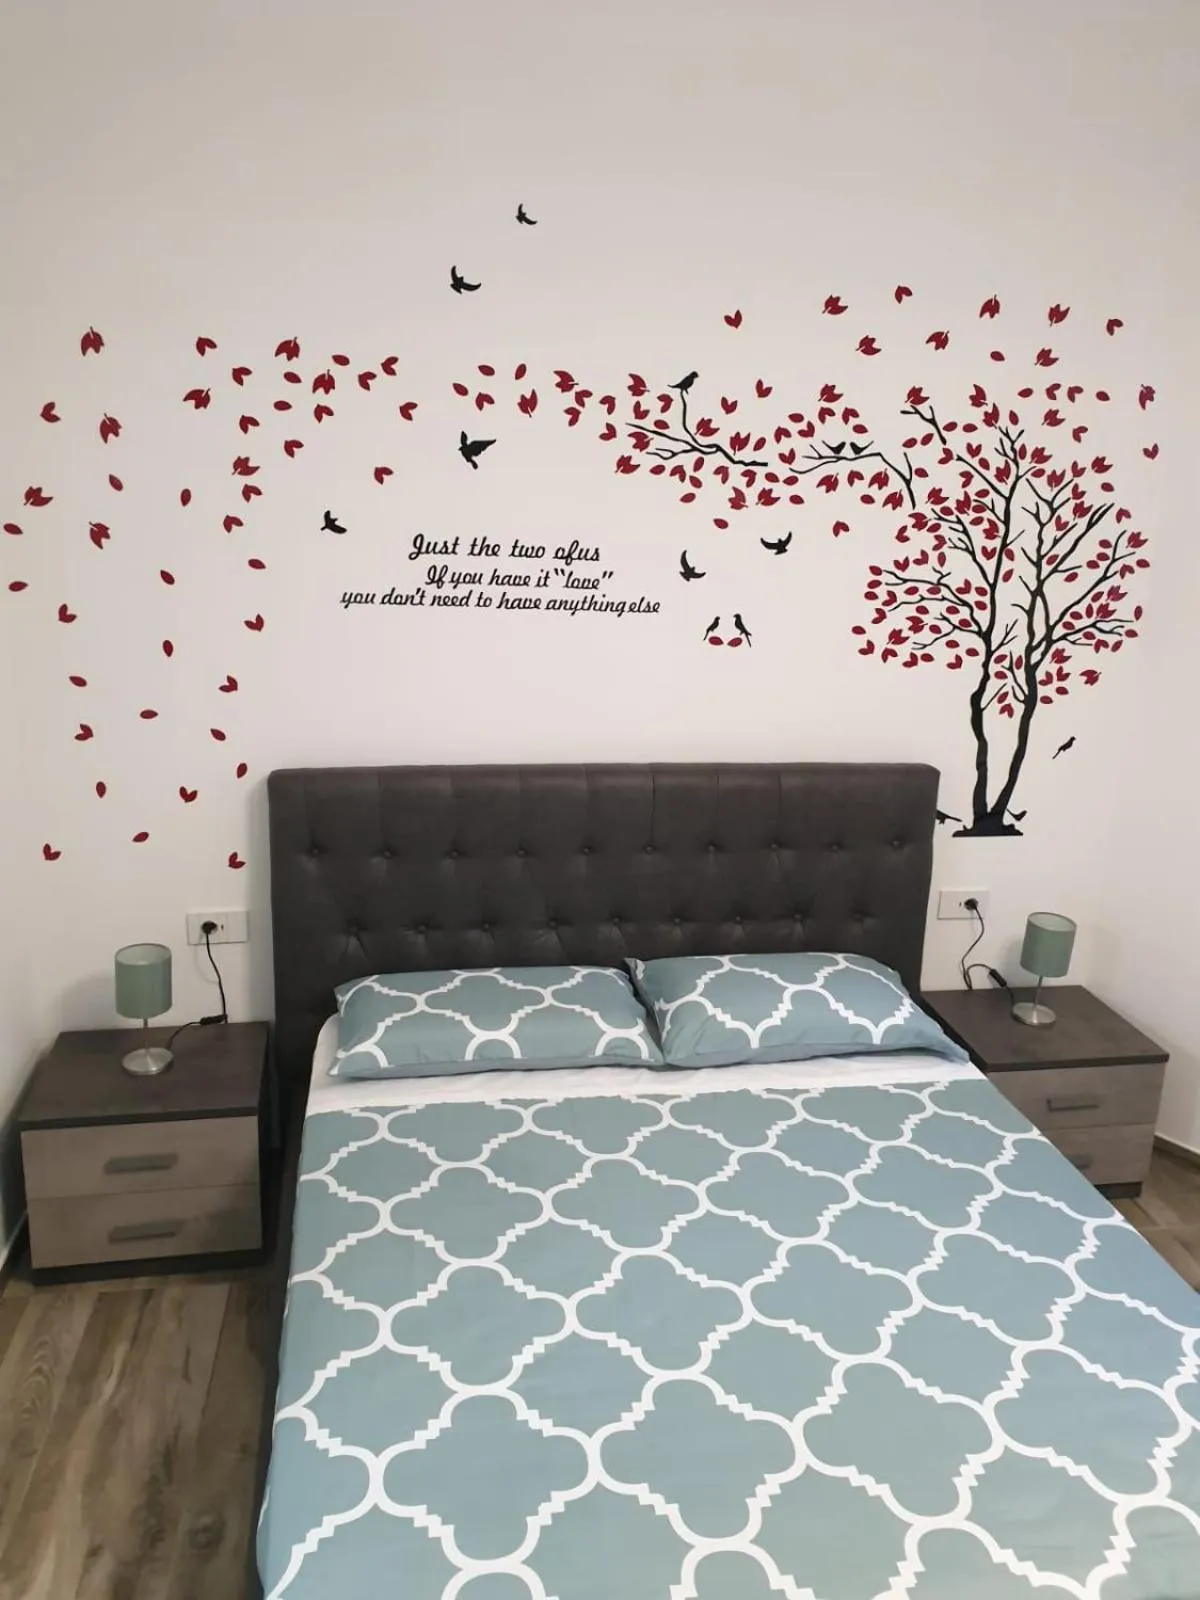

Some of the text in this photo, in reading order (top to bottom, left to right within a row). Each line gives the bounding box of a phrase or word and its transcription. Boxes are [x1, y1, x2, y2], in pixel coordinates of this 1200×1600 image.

[408, 533, 460, 561] Just
[467, 536, 501, 557] the
[508, 539, 546, 559] two
[424, 564, 449, 589] If
[448, 571, 484, 590] you
[487, 568, 531, 587] have
[534, 568, 551, 588] it
[340, 591, 377, 610] you
[429, 589, 473, 608] need
[474, 591, 493, 608] to
[495, 591, 542, 610] have
[544, 593, 627, 618] anything
[626, 596, 661, 614] else
